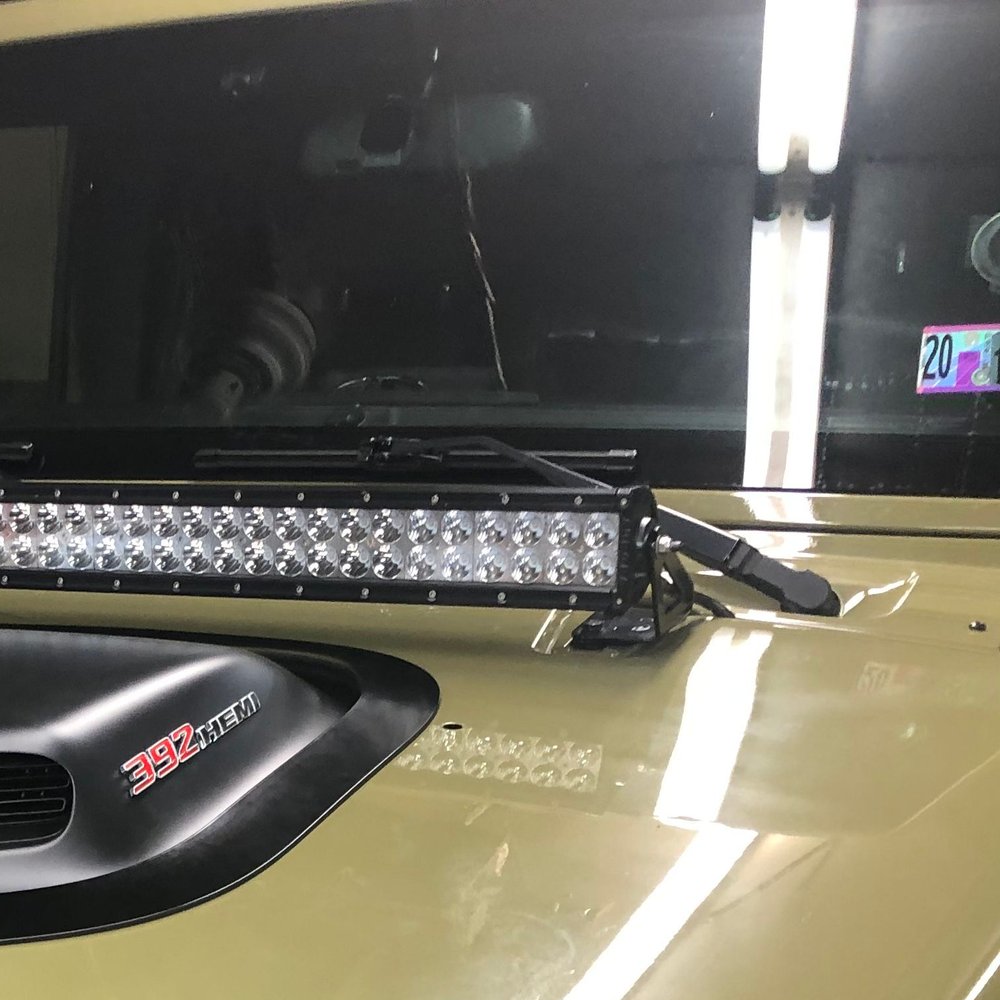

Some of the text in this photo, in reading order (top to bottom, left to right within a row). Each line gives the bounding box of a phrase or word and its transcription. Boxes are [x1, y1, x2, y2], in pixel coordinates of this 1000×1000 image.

[923, 333, 953, 379] 20
[120, 691, 262, 797] 392 HEMI
